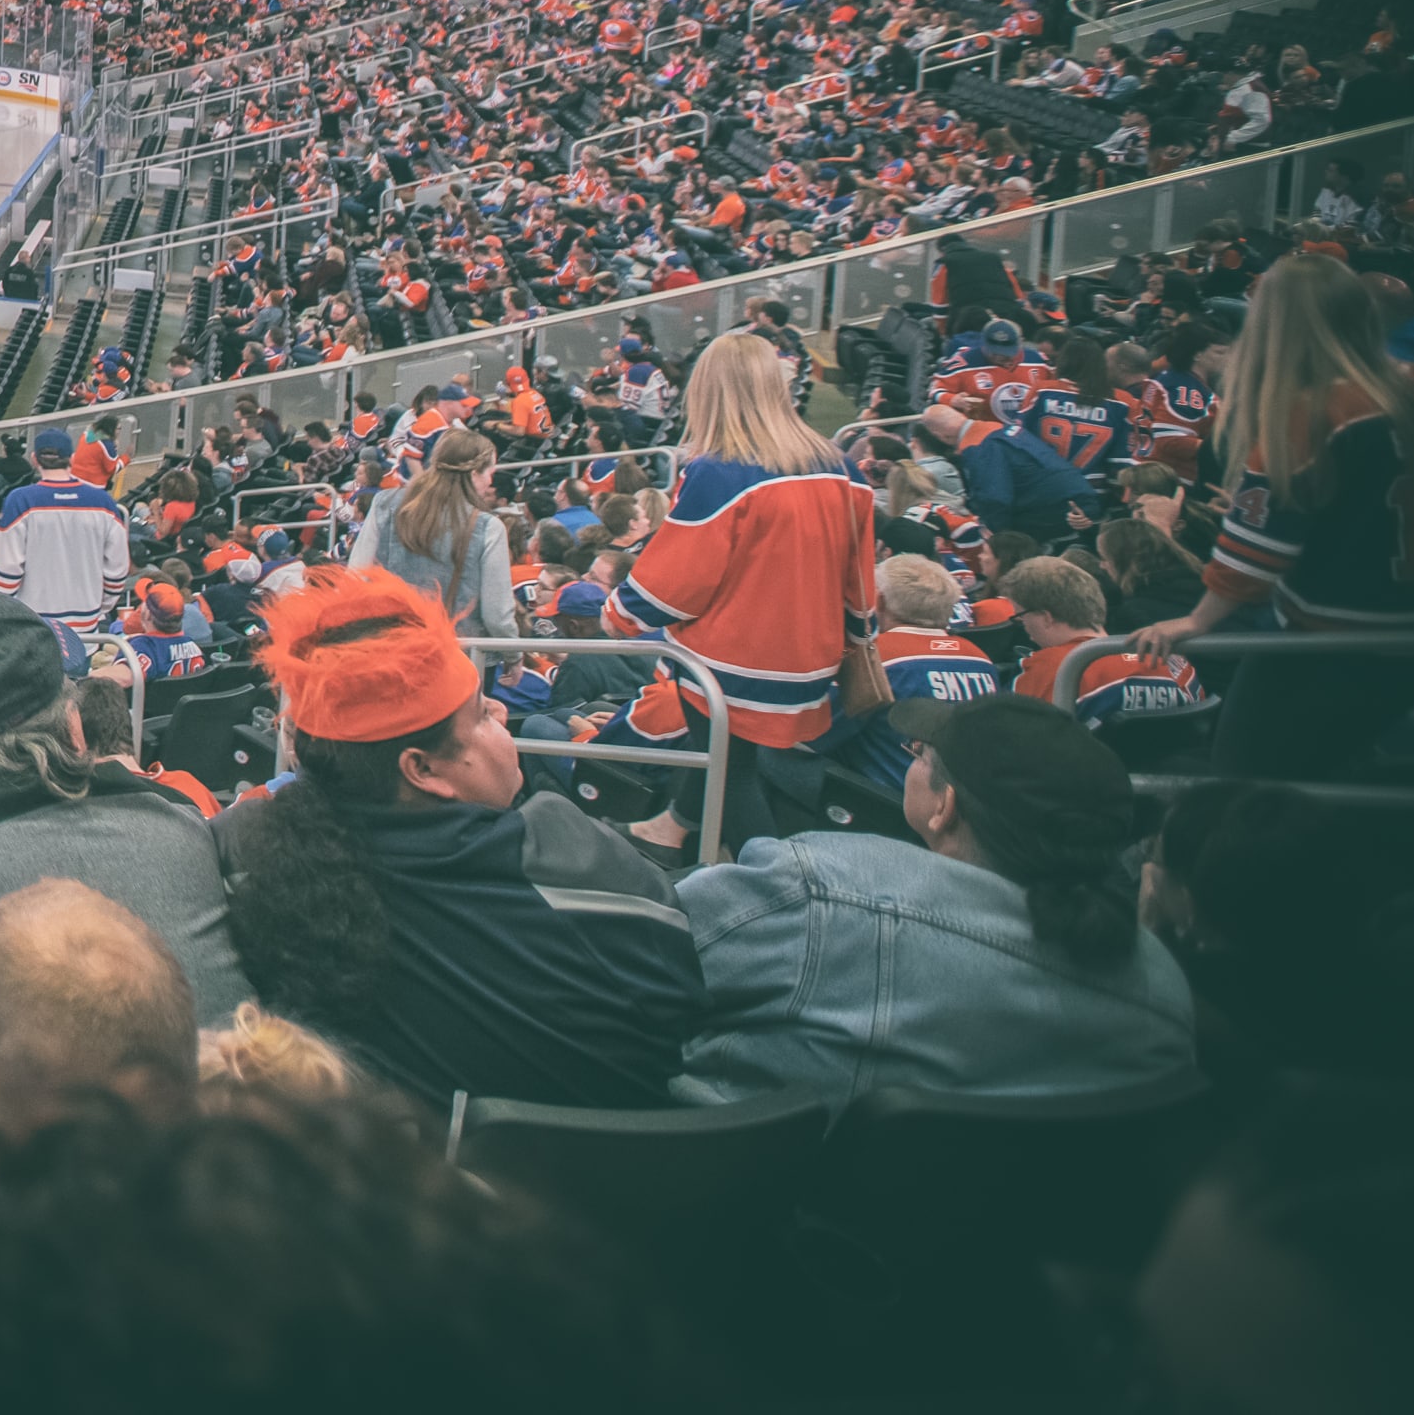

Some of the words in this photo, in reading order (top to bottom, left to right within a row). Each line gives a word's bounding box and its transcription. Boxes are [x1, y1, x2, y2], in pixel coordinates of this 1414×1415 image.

[19, 72, 40, 86] SN
[1040, 417, 1113, 468] 97
[927, 670, 996, 701] SMYTH
